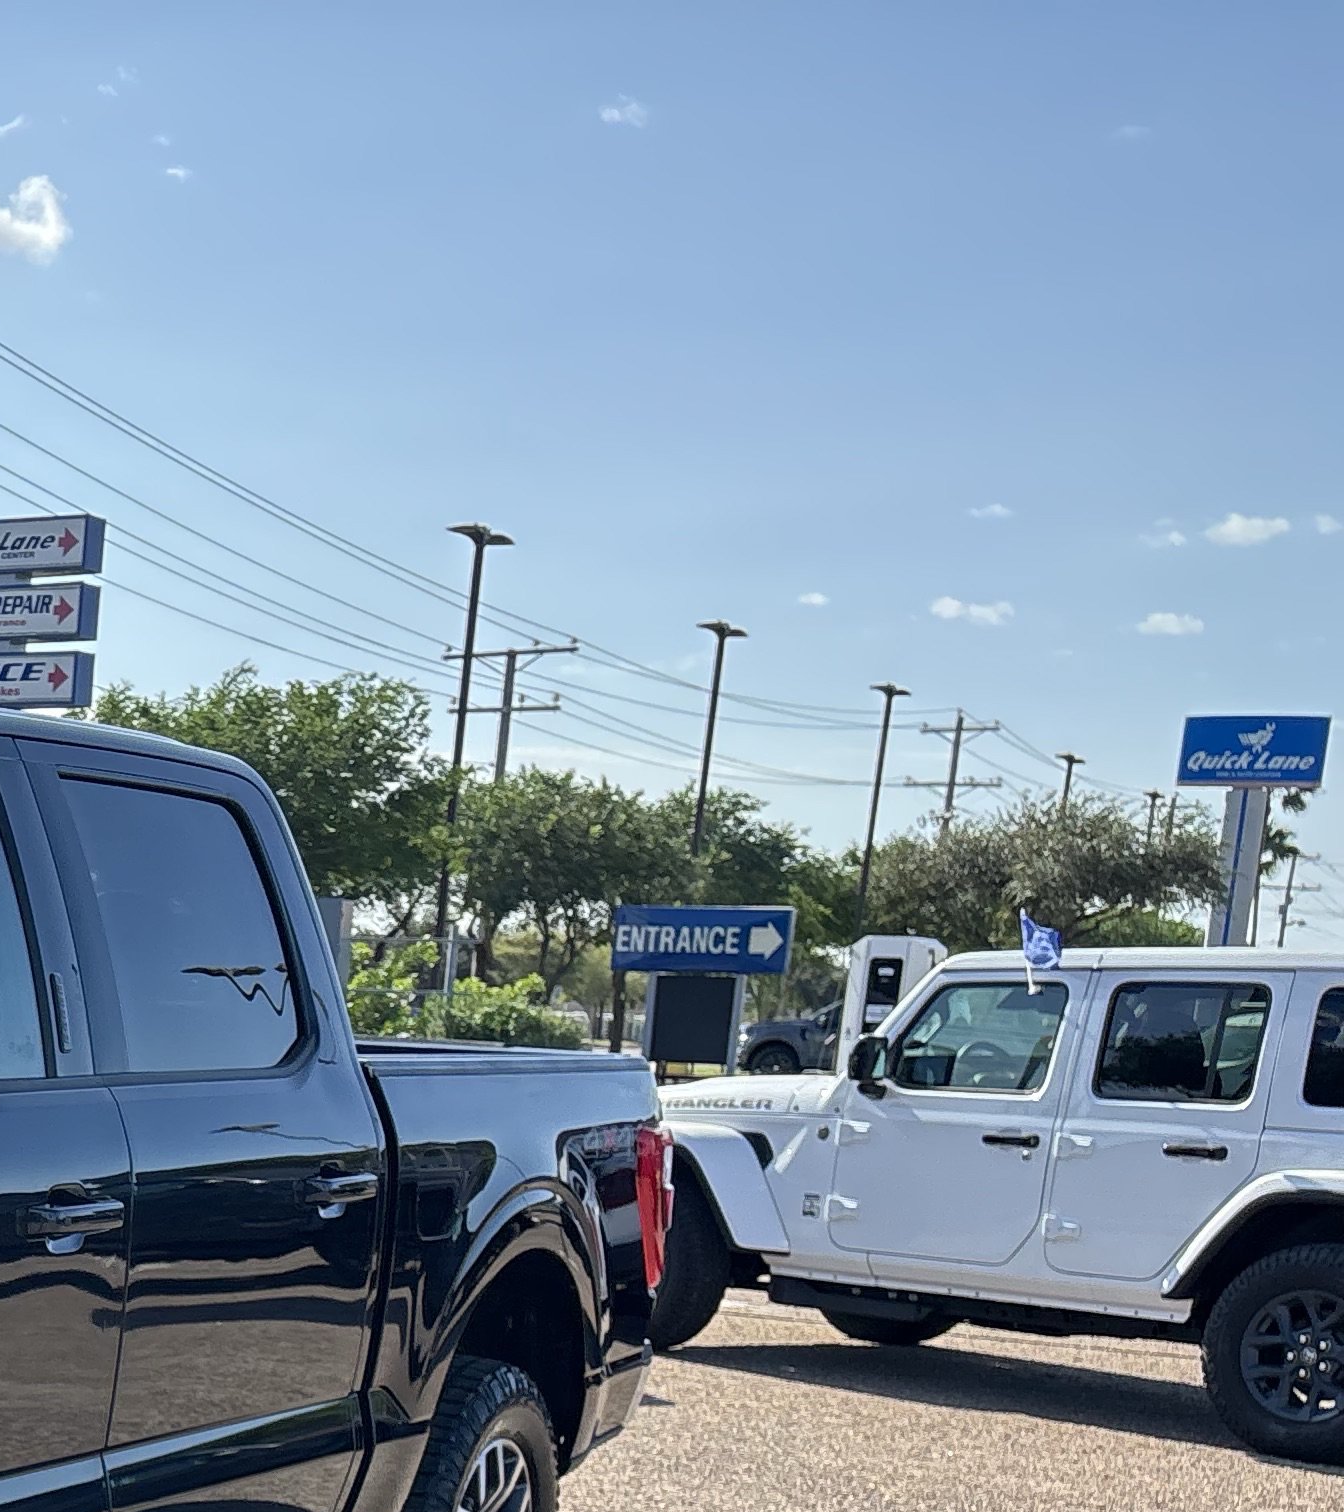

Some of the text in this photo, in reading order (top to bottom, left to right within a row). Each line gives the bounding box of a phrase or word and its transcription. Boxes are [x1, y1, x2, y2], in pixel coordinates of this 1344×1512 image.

[1, 551, 35, 559] CENTER
[1187, 750, 1316, 772] Quick Lane
[616, 924, 742, 955] ENTRANCE
